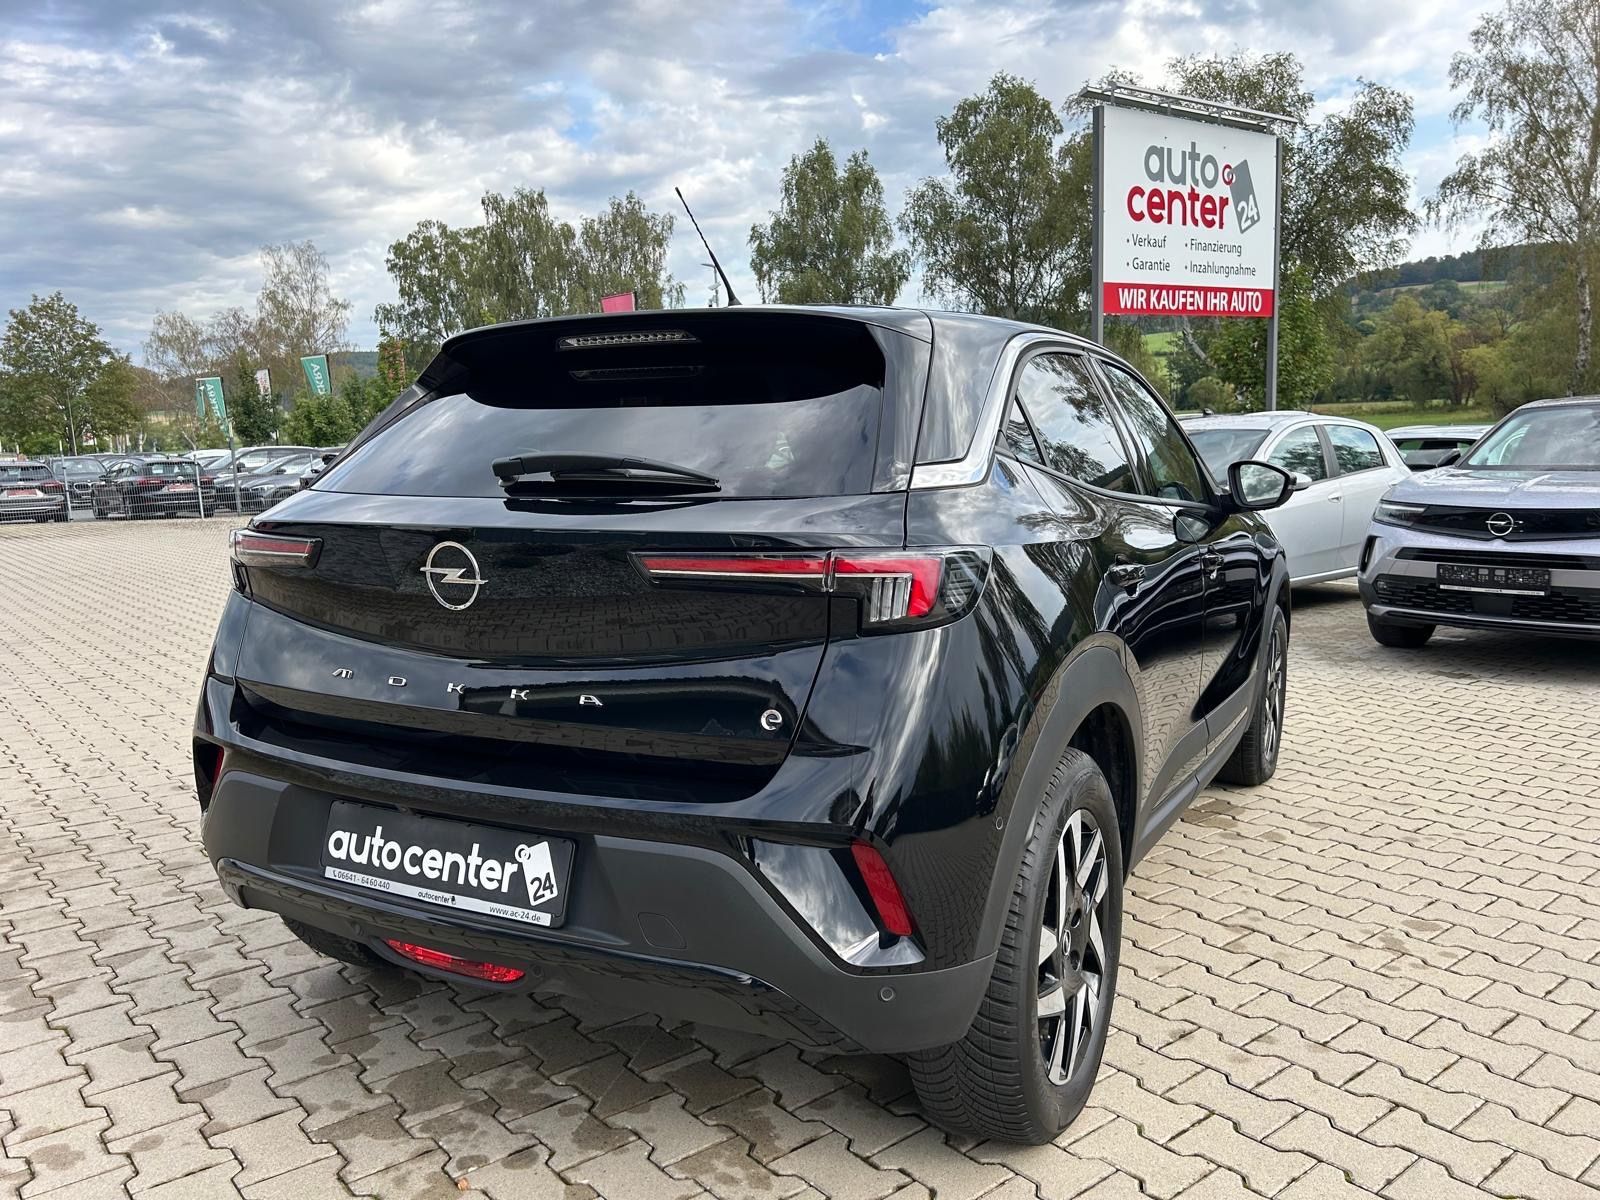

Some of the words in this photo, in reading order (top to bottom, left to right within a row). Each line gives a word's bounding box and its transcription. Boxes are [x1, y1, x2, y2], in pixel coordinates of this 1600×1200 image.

[1144, 141, 1219, 189] auto
[1127, 185, 1229, 230] center
[1236, 195, 1258, 230] 24
[1131, 234, 1167, 249] Verkauf
[1190, 238, 1242, 257] Finanzierung
[1132, 257, 1171, 272] Garantie
[1189, 261, 1256, 278] Inzahlungnahme
[1118, 287, 1147, 309] WIR
[1149, 289, 1203, 311] KAUFEN
[1206, 290, 1229, 312] IHR
[1231, 291, 1262, 313] AUTO
[332, 668, 604, 707] MOKKA
[760, 709, 783, 731] e
[327, 825, 518, 893] autocenter
[417, 891, 450, 905] autocenter
[529, 872, 554, 902] 24
[489, 905, 541, 923] www.ac-24.de
